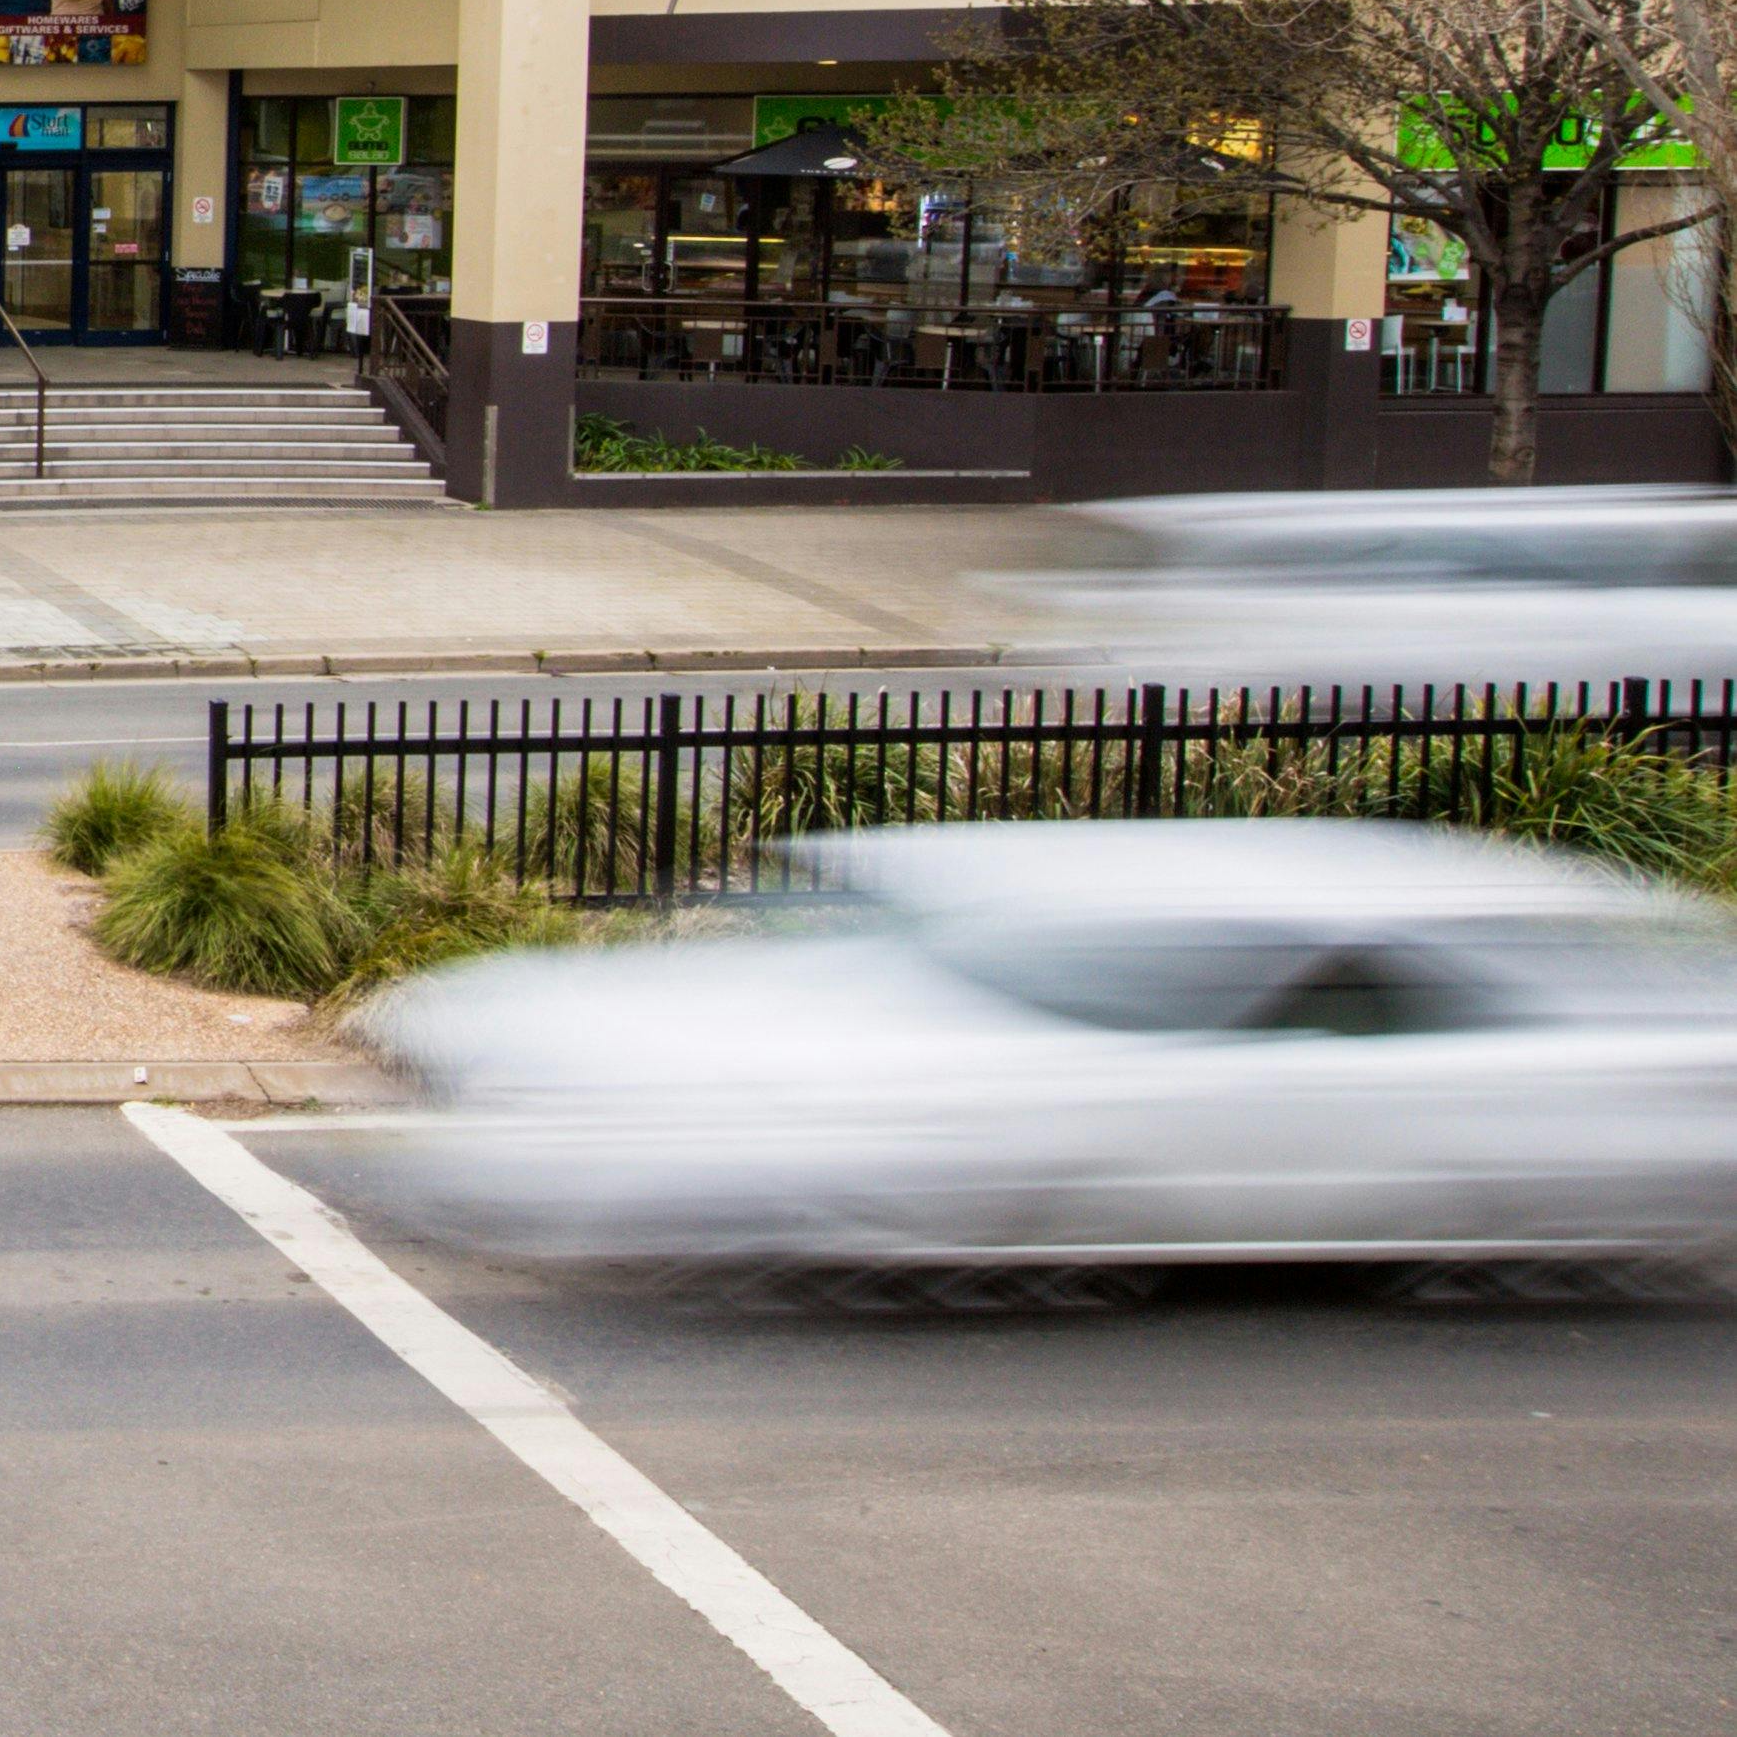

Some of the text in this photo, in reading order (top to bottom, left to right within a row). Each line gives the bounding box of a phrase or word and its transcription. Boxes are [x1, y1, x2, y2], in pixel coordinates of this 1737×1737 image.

[27, 16, 99, 24] HOMEWARES
[64, 25, 73, 34] &
[76, 25, 129, 34] SERVICES
[31, 113, 69, 130] Sturt
[41, 126, 69, 137] mall
